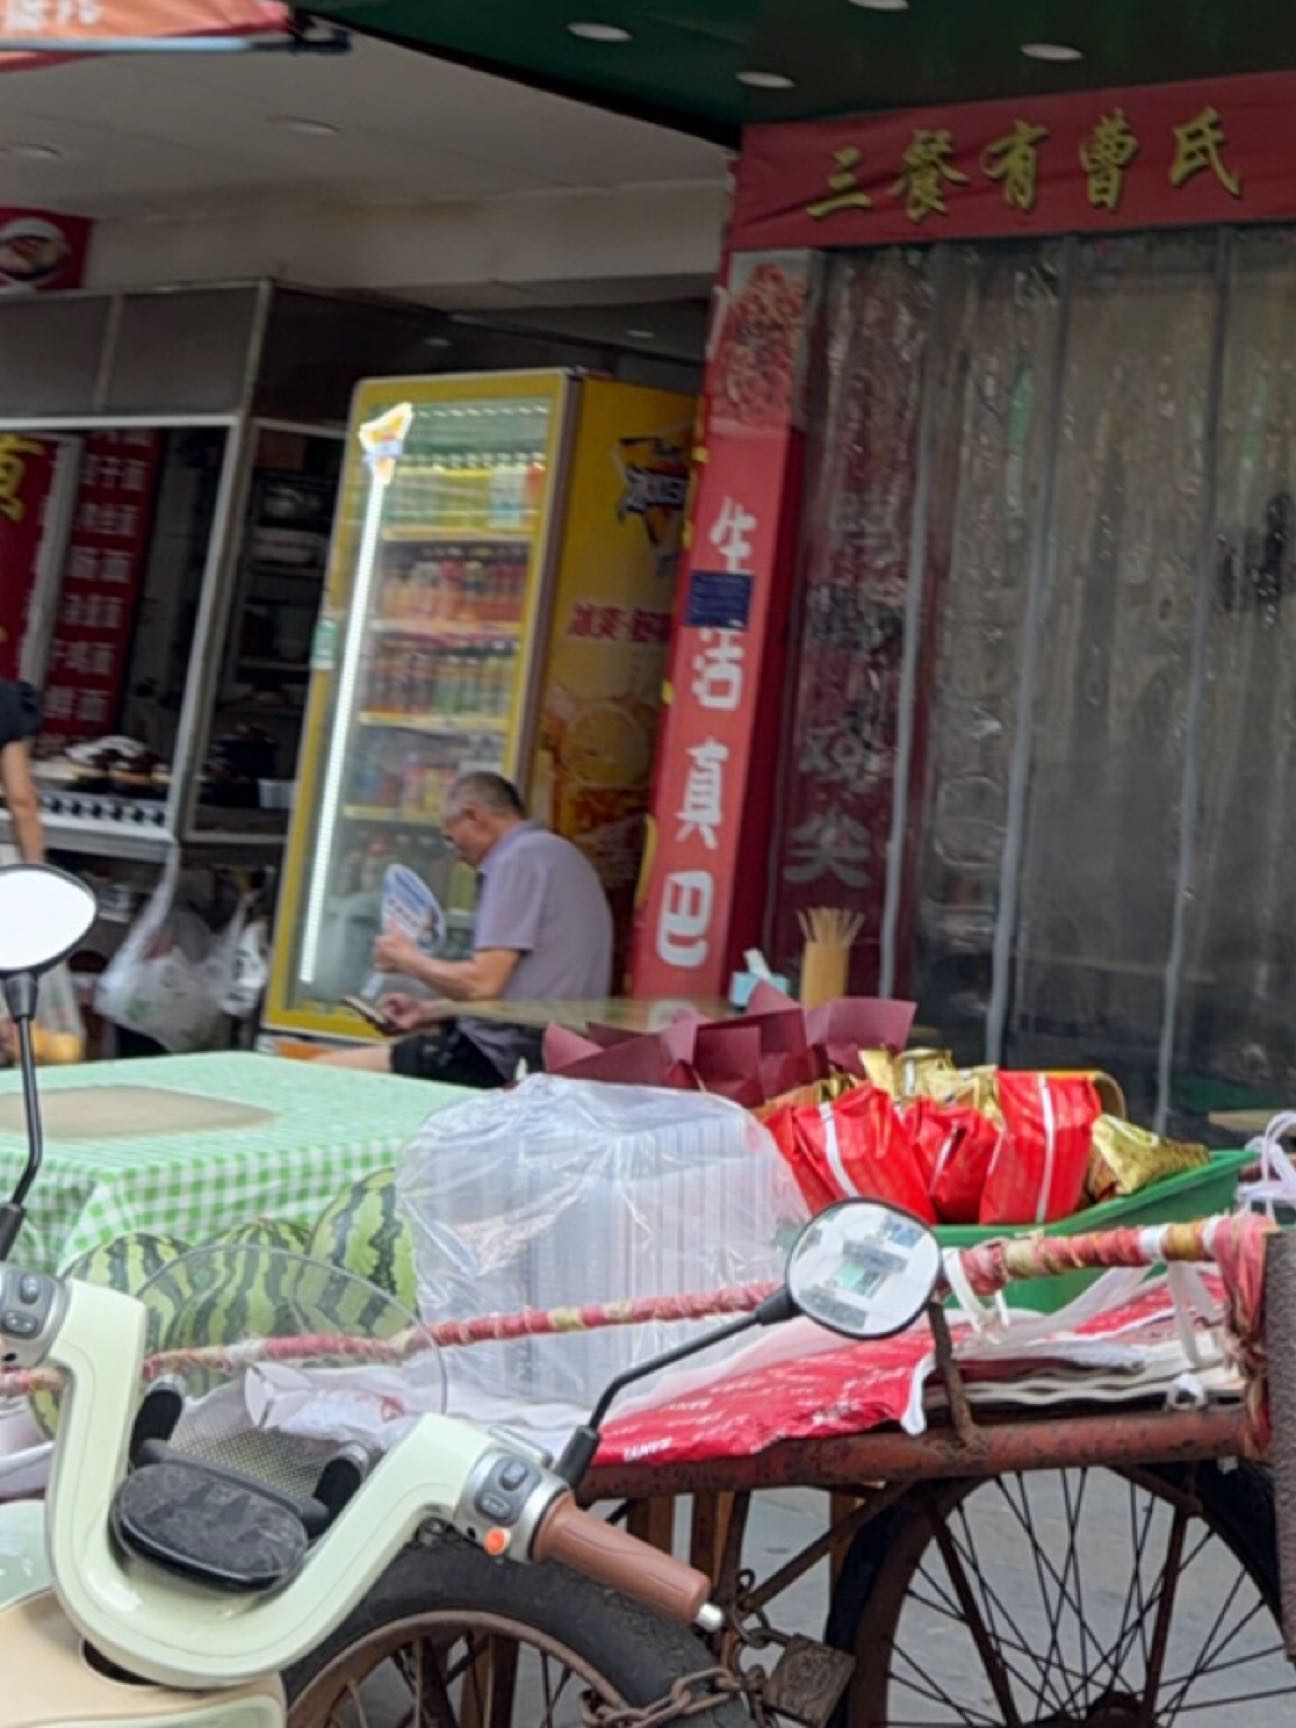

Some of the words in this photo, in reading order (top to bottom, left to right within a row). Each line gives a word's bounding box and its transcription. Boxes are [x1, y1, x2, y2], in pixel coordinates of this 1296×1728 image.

[806, 105, 1242, 224] 三餐有曹氏
